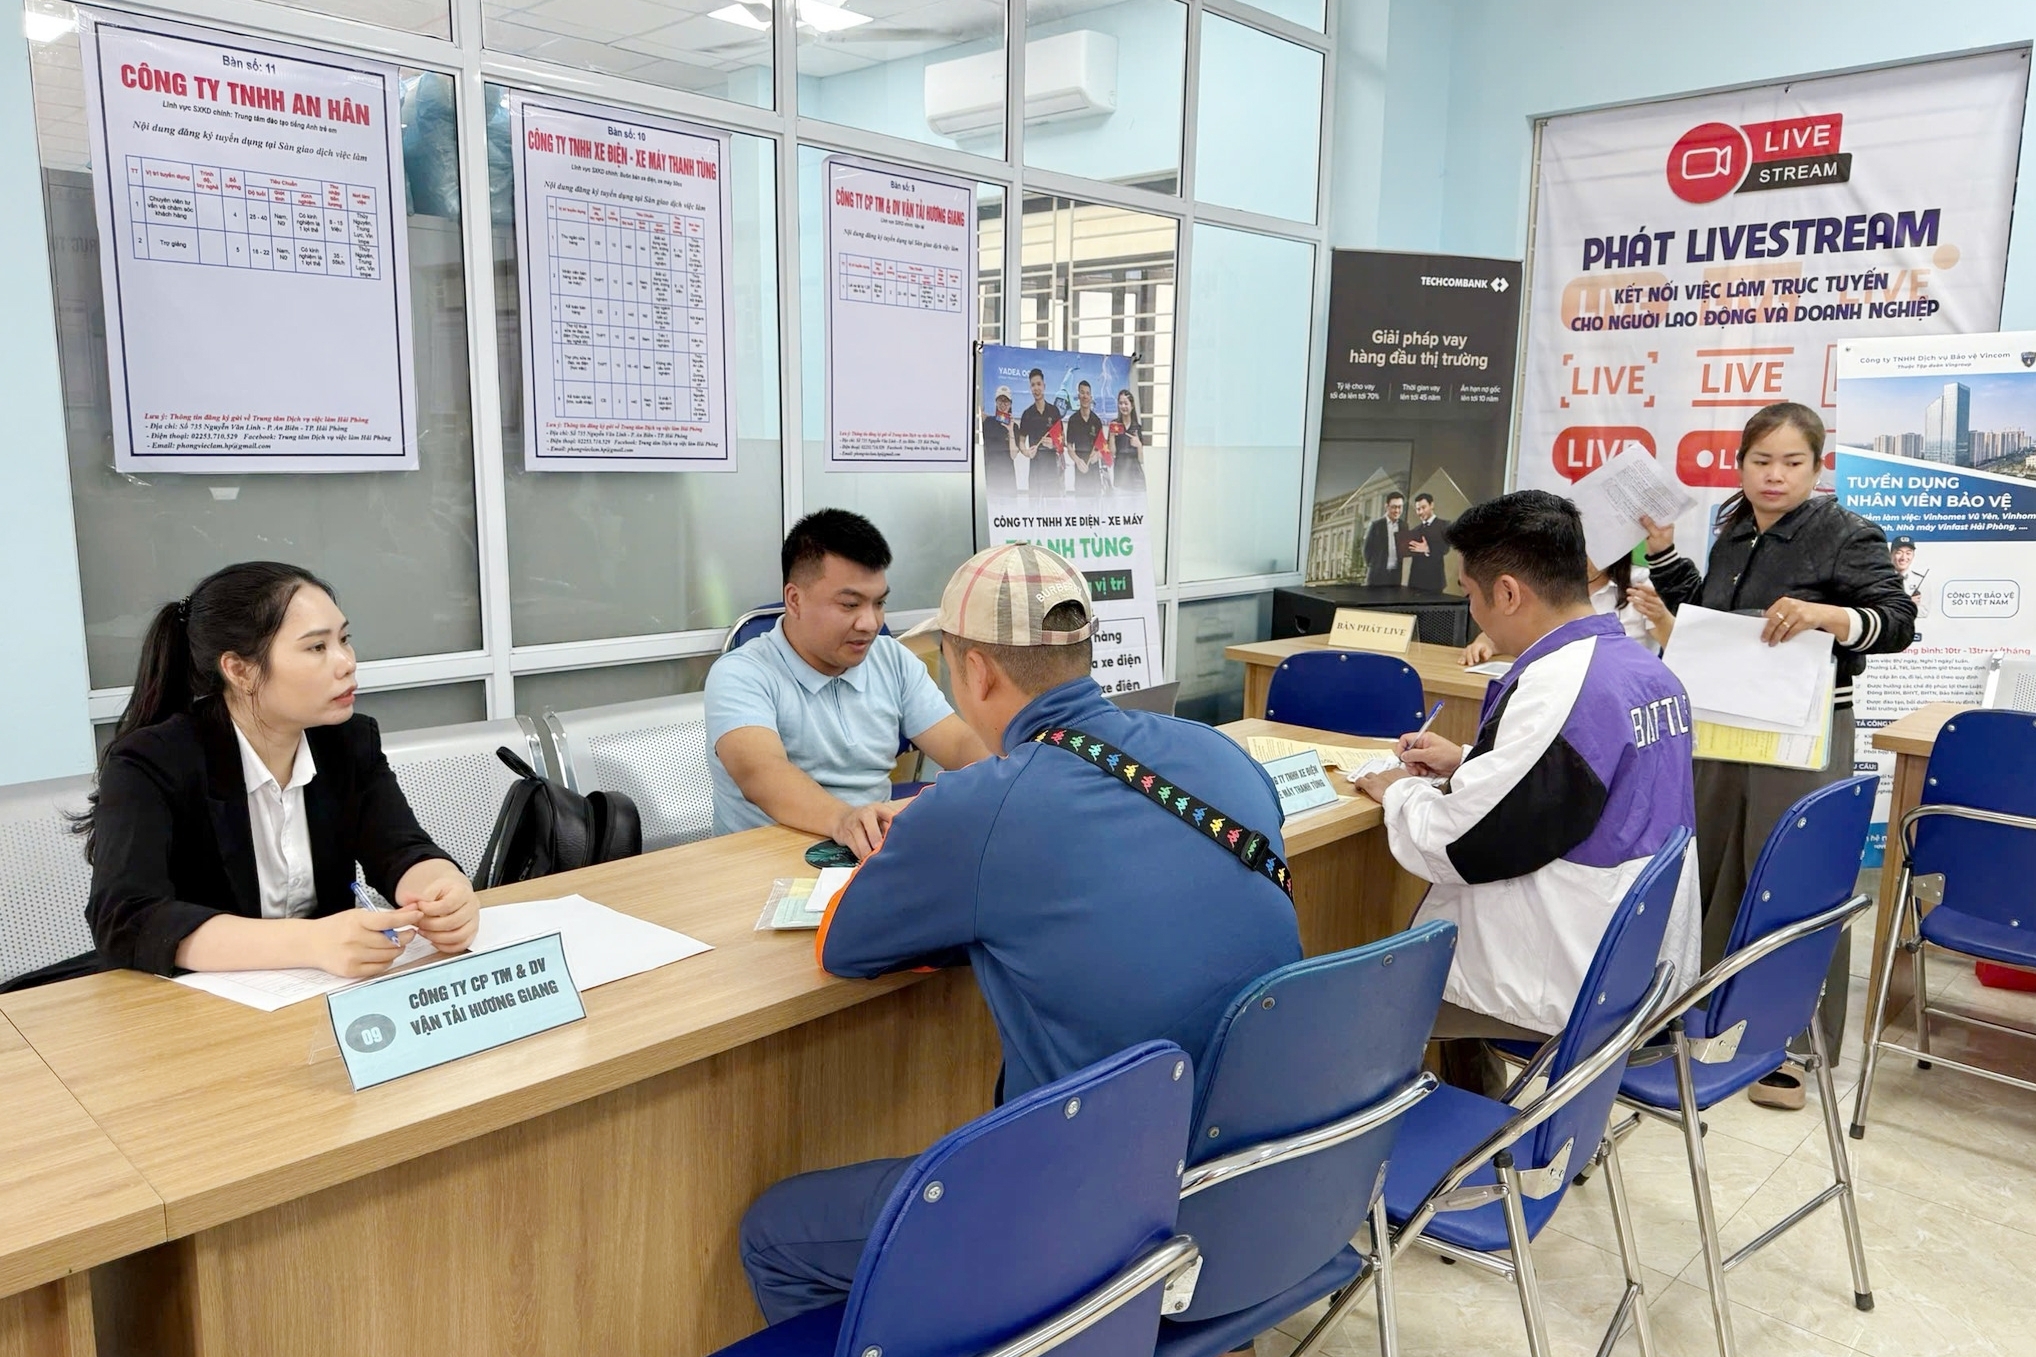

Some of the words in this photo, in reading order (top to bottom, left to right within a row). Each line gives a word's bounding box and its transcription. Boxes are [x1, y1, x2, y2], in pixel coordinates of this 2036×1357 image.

[222, 55, 243, 69] Bàn
[246, 58, 262, 72] số:
[266, 64, 276, 74] 11
[121, 62, 188, 96] CÔNG
[194, 76, 220, 102] TY
[226, 82, 285, 112] TNHH
[292, 92, 322, 118] AN
[328, 97, 370, 126] HÂN
[132, 120, 150, 132] Nội
[152, 122, 175, 136] dung
[178, 127, 200, 140] đăng
[202, 130, 214, 142] ký
[216, 132, 238, 145] tuyển
[242, 136, 262, 149] dụng
[266, 140, 276, 150] tại
[278, 141, 294, 152] Sàn
[296, 145, 314, 154] giao
[316, 148, 334, 158] dịch
[336, 150, 351, 160] việc
[352, 151, 368, 162] làm
[608, 126, 622, 138] Bàn
[624, 129, 636, 140] số:
[638, 132, 646, 141] 10
[1764, 122, 1833, 152] LIVE
[528, 128, 553, 152] CÔNG
[556, 135, 566, 154] TY
[569, 138, 591, 160] TNHH
[594, 142, 605, 162] XE
[608, 142, 627, 168] ĐIỆN
[636, 149, 646, 168] XE
[649, 147, 666, 172] MÁY
[669, 154, 695, 177] THANH
[696, 157, 716, 180] TÙNG
[1758, 162, 1838, 184] STREAM
[836, 186, 854, 208] CÔNG
[856, 191, 863, 209] TY
[865, 194, 874, 210] CP
[875, 196, 884, 212] TM
[886, 198, 890, 214] &
[892, 200, 901, 216] DV
[902, 198, 914, 220] VẬN
[916, 198, 925, 220] TẢI
[926, 203, 946, 224] HƯƠNG
[948, 208, 965, 227] GIANG
[1583, 226, 1675, 271] PHÁT
[1687, 208, 1941, 263] LIVESTREAM
[1420, 276, 1488, 288] TECHCOMBANK
[1614, 281, 1646, 304] KẾT
[1648, 280, 1678, 303] NỐI
[1685, 278, 1721, 302] VIỆC
[1726, 276, 1765, 299] LÀM
[1772, 274, 1818, 298] TRỰC
[1826, 268, 1889, 292] TUYẾN
[1571, 316, 1603, 332] CHO
[1608, 310, 1660, 330] NGƯỜI
[1664, 310, 1697, 327] LAO
[1704, 305, 1756, 329] ĐỘNG
[1763, 304, 1788, 323] VÀ
[1794, 301, 1862, 322] DOANH
[1868, 294, 1940, 319] NGHIỆP
[1372, 330, 1400, 345] Giải
[1403, 331, 1439, 347] pháp
[1443, 335, 1468, 350] vay
[1350, 350, 1386, 367] hàng
[1389, 348, 1416, 364] đầu
[1420, 352, 1438, 368] thị
[1442, 353, 1488, 369] trường
[1860, 356, 1880, 364] Công
[1882, 356, 1890, 364] ty
[1918, 354, 1936, 363] Dịch
[1968, 352, 1978, 360] vệ
[999, 366, 1020, 376] YADEA
[1570, 364, 1646, 396] LIVE
[1700, 360, 1784, 394] LIVE
[1847, 472, 1903, 489] TUYỂN
[1908, 476, 1960, 492] DỤNG
[1846, 492, 1896, 507] NHÂN
[1901, 492, 1942, 507] VIÊN
[1946, 491, 1984, 507] BẢO
[1989, 492, 2012, 510] VỆ
[994, 514, 1020, 528] CÔNG
[1022, 517, 1034, 528] TY
[1036, 517, 1061, 527] TNHH
[1065, 516, 1076, 527] XE
[1079, 513, 1100, 530] ĐIỆN
[1107, 516, 1120, 526] XE
[1123, 513, 1144, 526] MÁY
[1882, 513, 1899, 521] làm
[1901, 513, 1921, 522] việc:
[1923, 513, 1966, 521] Vinhomes
[1968, 512, 1980, 520] Vũ
[1982, 512, 2000, 521] Yên,
[1896, 523, 1914, 531] Nhà
[1916, 524, 1936, 532] máy
[1970, 522, 1986, 530] Hải
[1987, 522, 2017, 532] Phòng,
[1080, 532, 1134, 558] TÙNG
[1095, 576, 1107, 595] vị
[1110, 576, 1126, 591] trí
[1947, 590, 1970, 599] CÔNG
[1984, 590, 2002, 598] BẢO
[2004, 590, 2015, 600] VỆ
[1952, 598, 1963, 606] SỐ
[1970, 598, 1987, 606] VIỆT
[1094, 630, 1122, 645] hàng
[1336, 620, 1355, 631] BÀN
[1358, 622, 1381, 634] PHÁT
[1383, 626, 1407, 637] LIVE
[1102, 659, 1113, 668] xe
[1117, 654, 1142, 669] điện
[1630, 694, 1690, 750] BATTL
[1278, 775, 1285, 784] TY
[1285, 770, 1299, 782] TNHH
[1298, 769, 1307, 778] XE
[1306, 764, 1319, 776] ĐIỆN
[1282, 784, 1295, 798] MÁY
[1294, 782, 1312, 794] THANH
[1310, 778, 1326, 790] TÙNG
[408, 989, 449, 1010] CÔNG
[450, 980, 467, 999] TY
[471, 975, 488, 993] CP
[492, 965, 514, 986] TM
[516, 964, 527, 978] &
[529, 957, 547, 976] DV
[410, 1015, 443, 1036] VẬN
[443, 1004, 466, 1026] TẢI
[471, 992, 516, 1020] HƯƠNG
[517, 979, 559, 1005] GIANG
[360, 1026, 383, 1046] 09
